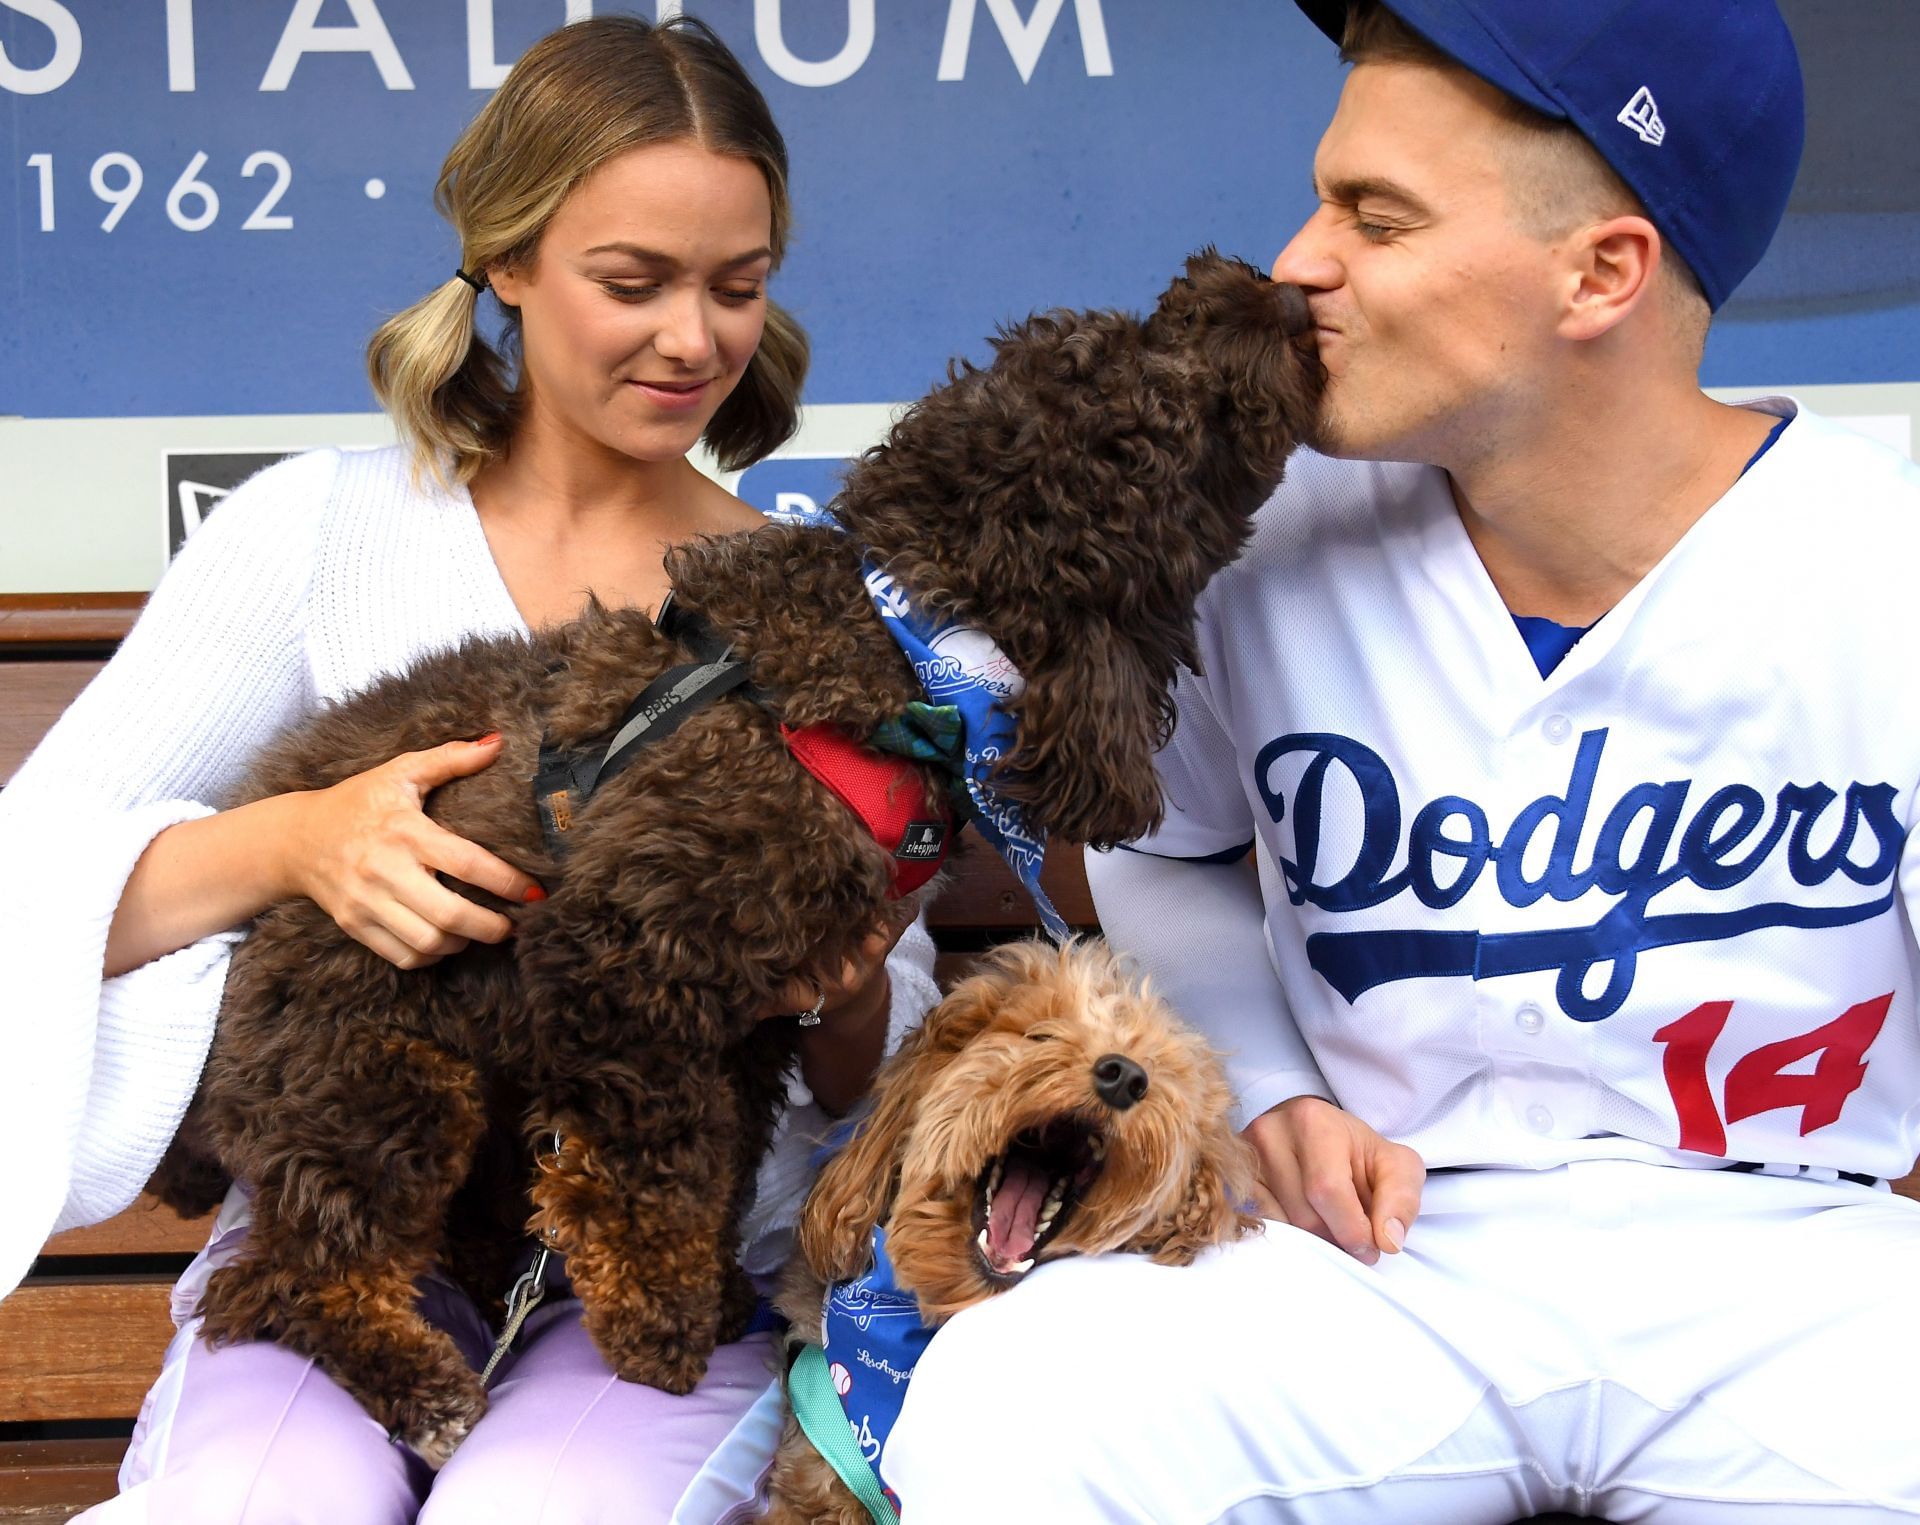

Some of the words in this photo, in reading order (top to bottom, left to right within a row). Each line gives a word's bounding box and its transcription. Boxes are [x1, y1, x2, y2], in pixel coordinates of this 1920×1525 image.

[0, 0, 1115, 94] SAUM
[26, 151, 294, 233] 1962
[906, 840, 942, 856] sleepypod
[1254, 727, 1899, 1023] Dodgers
[1652, 990, 1895, 1157] 14
[857, 1348, 876, 1368] Los
